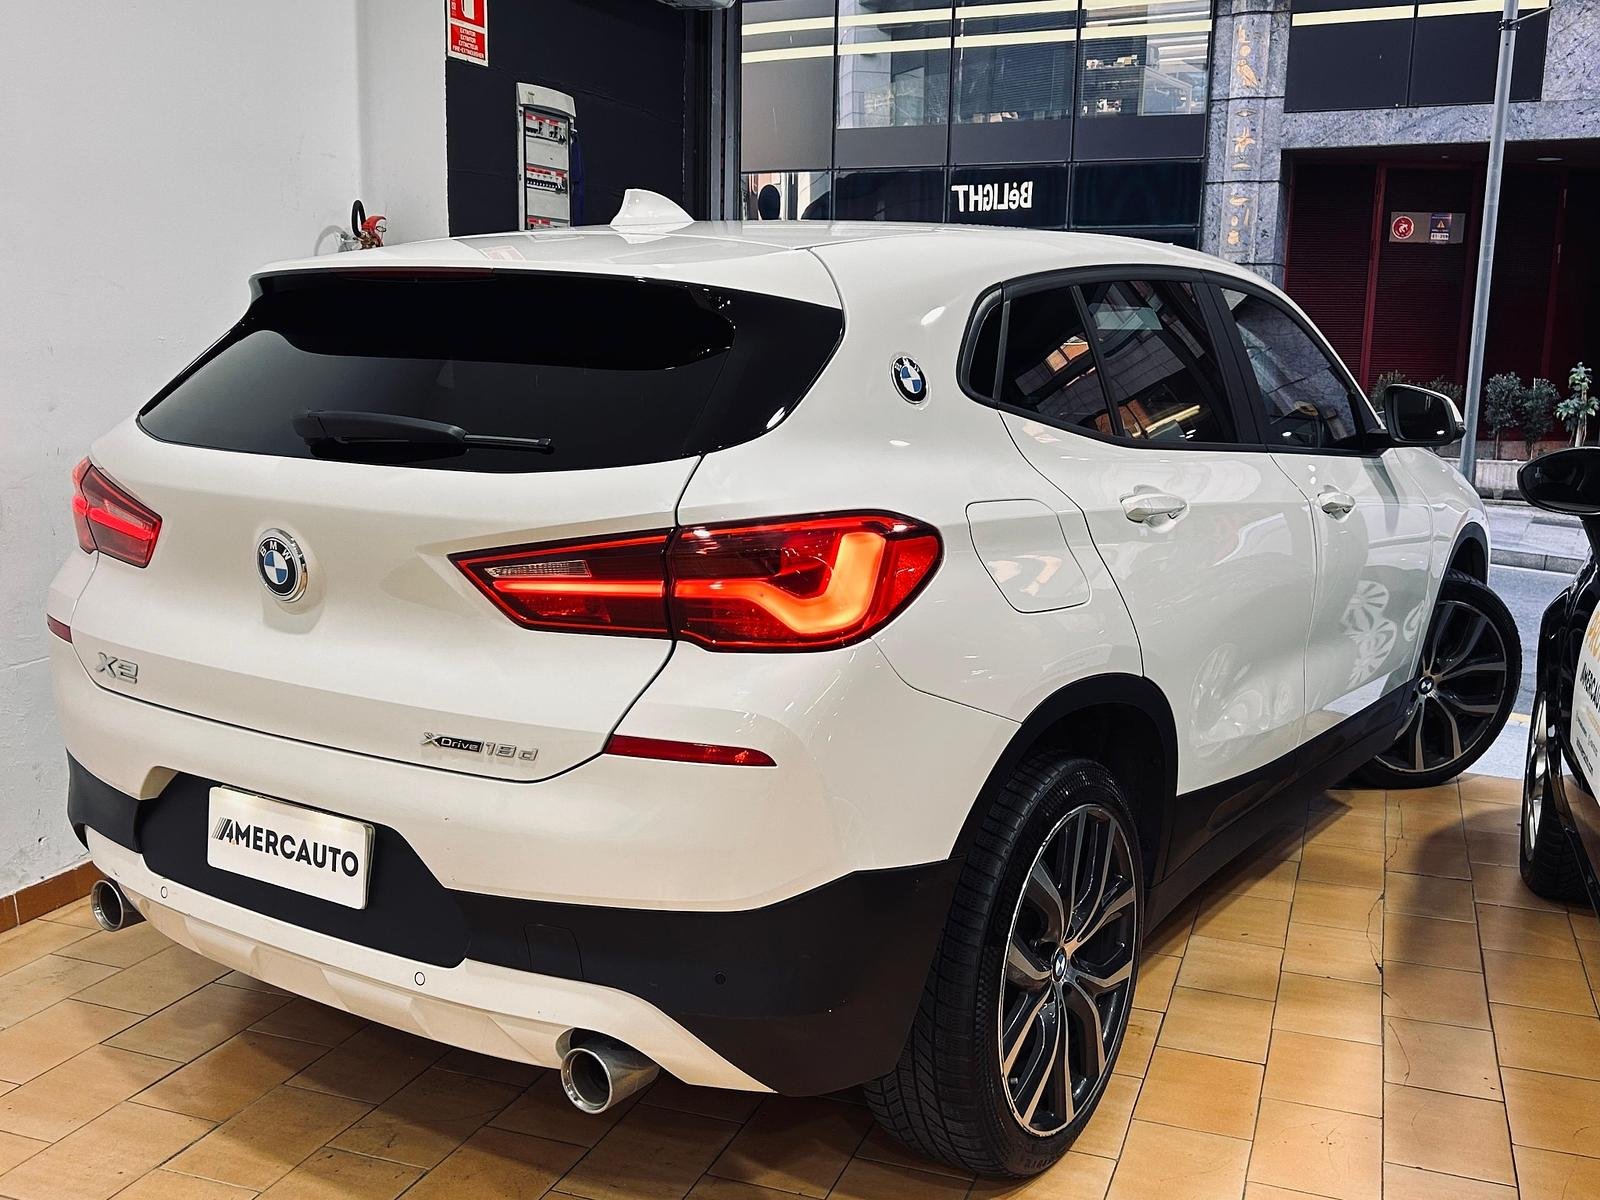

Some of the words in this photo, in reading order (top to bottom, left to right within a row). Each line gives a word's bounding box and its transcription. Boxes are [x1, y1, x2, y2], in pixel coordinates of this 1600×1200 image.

[260, 540, 292, 561] BMW
[96, 651, 138, 684] X2
[212, 816, 359, 877] AMERCAUTO
